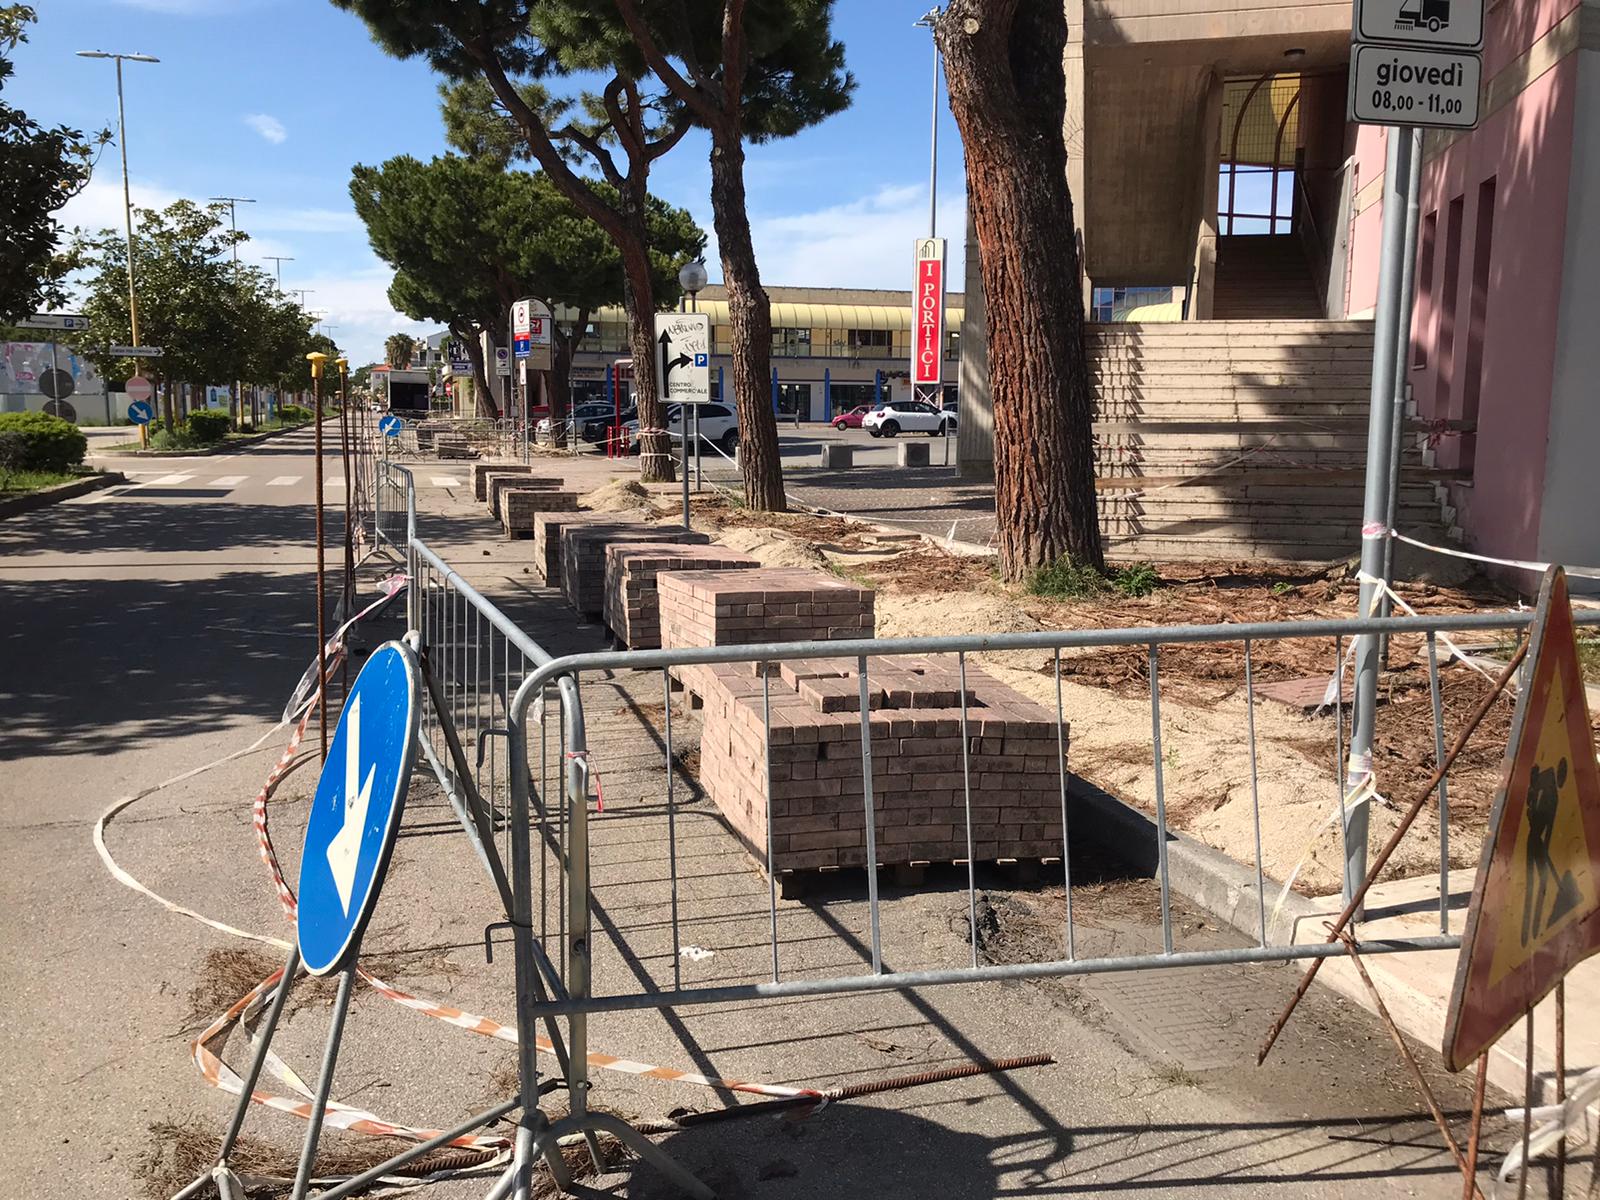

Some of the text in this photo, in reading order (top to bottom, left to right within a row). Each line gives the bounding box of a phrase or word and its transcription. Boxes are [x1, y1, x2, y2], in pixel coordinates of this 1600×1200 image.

[1376, 57, 1464, 87] giovedì
[1371, 89, 1414, 112] 08,00
[1428, 93, 1462, 115] 11,00
[921, 263, 936, 377] I PORTICI
